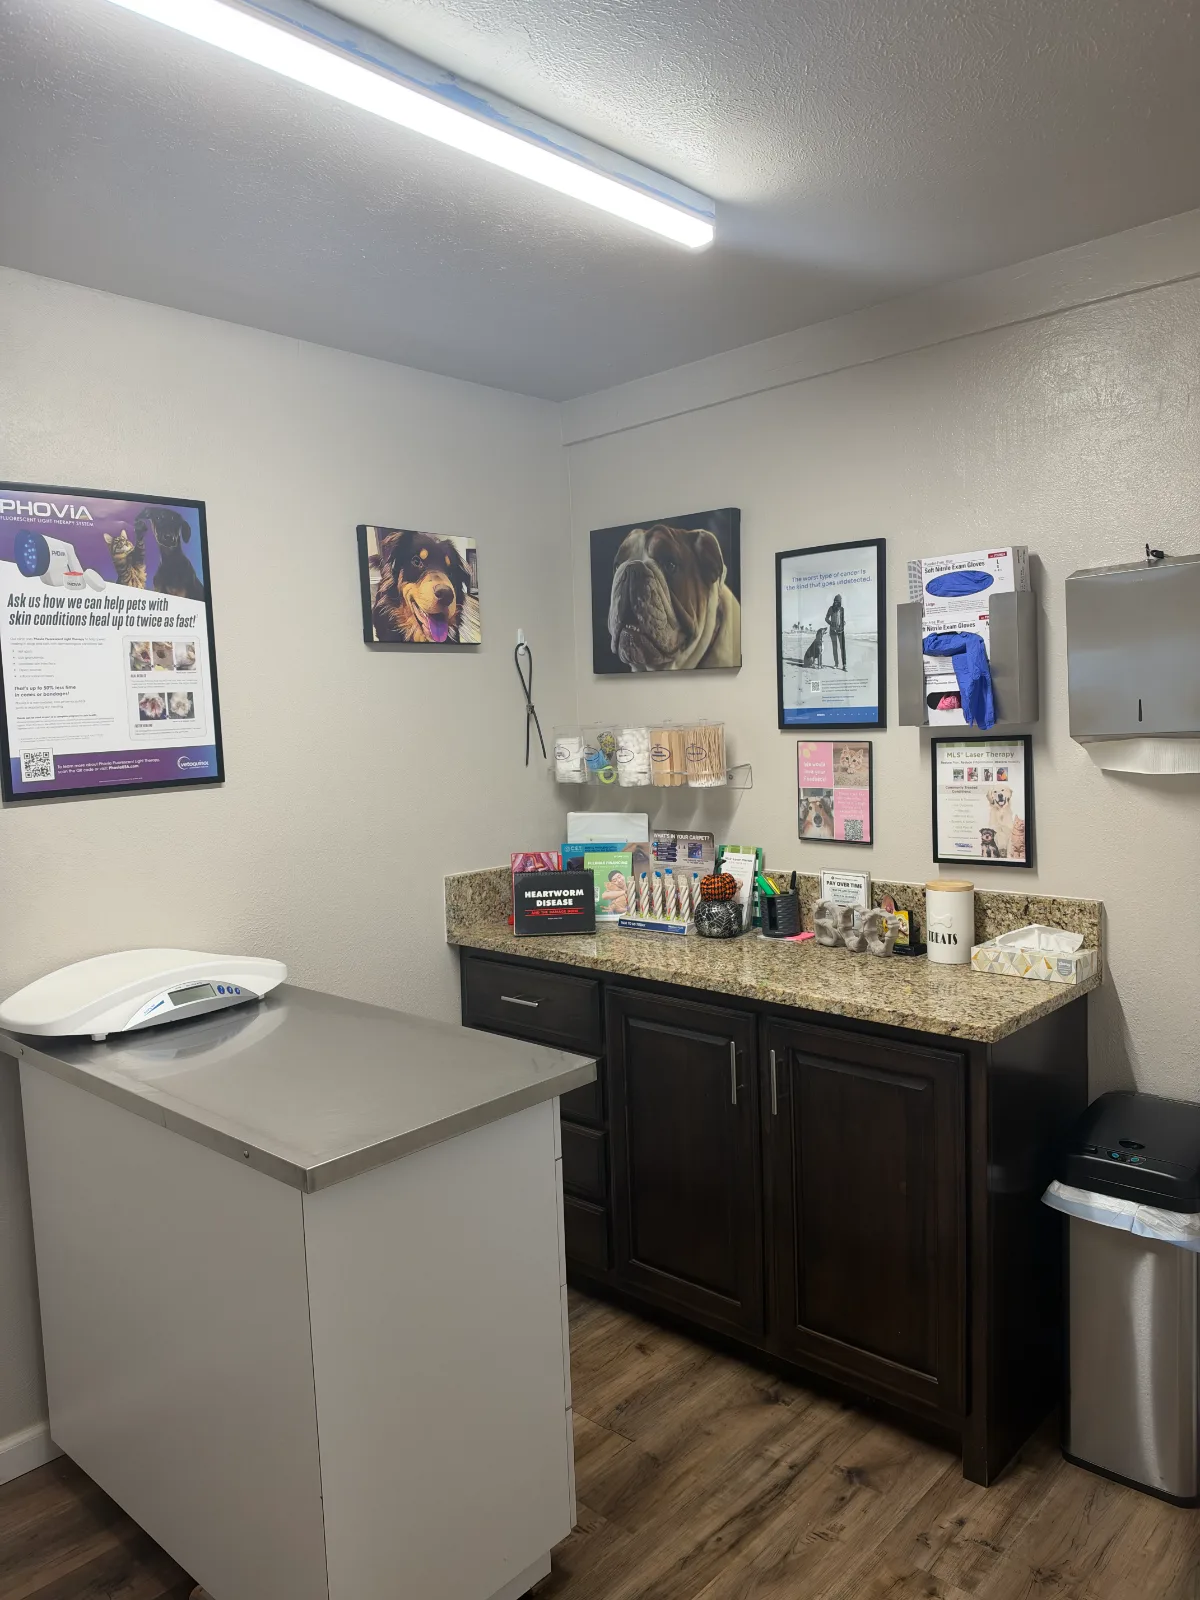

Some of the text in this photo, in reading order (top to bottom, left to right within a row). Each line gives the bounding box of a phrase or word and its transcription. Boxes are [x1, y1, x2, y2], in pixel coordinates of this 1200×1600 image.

[935, 565, 951, 573] Nitrile
[967, 560, 985, 568] Gloves
[820, 573, 832, 581] type
[822, 580, 836, 588] goes
[837, 576, 873, 585] undetected.
[7, 592, 169, 614] Ask us how we can help pets with
[9, 610, 196, 631] skin conditions heal up to twice as fast!
[943, 623, 957, 631] Exam
[958, 621, 976, 629] Gloves
[985, 751, 1015, 759] Therapy
[524, 888, 584, 898] HEARTWORM
[536, 898, 573, 907] DISEASE
[928, 929, 958, 946] TREATS
